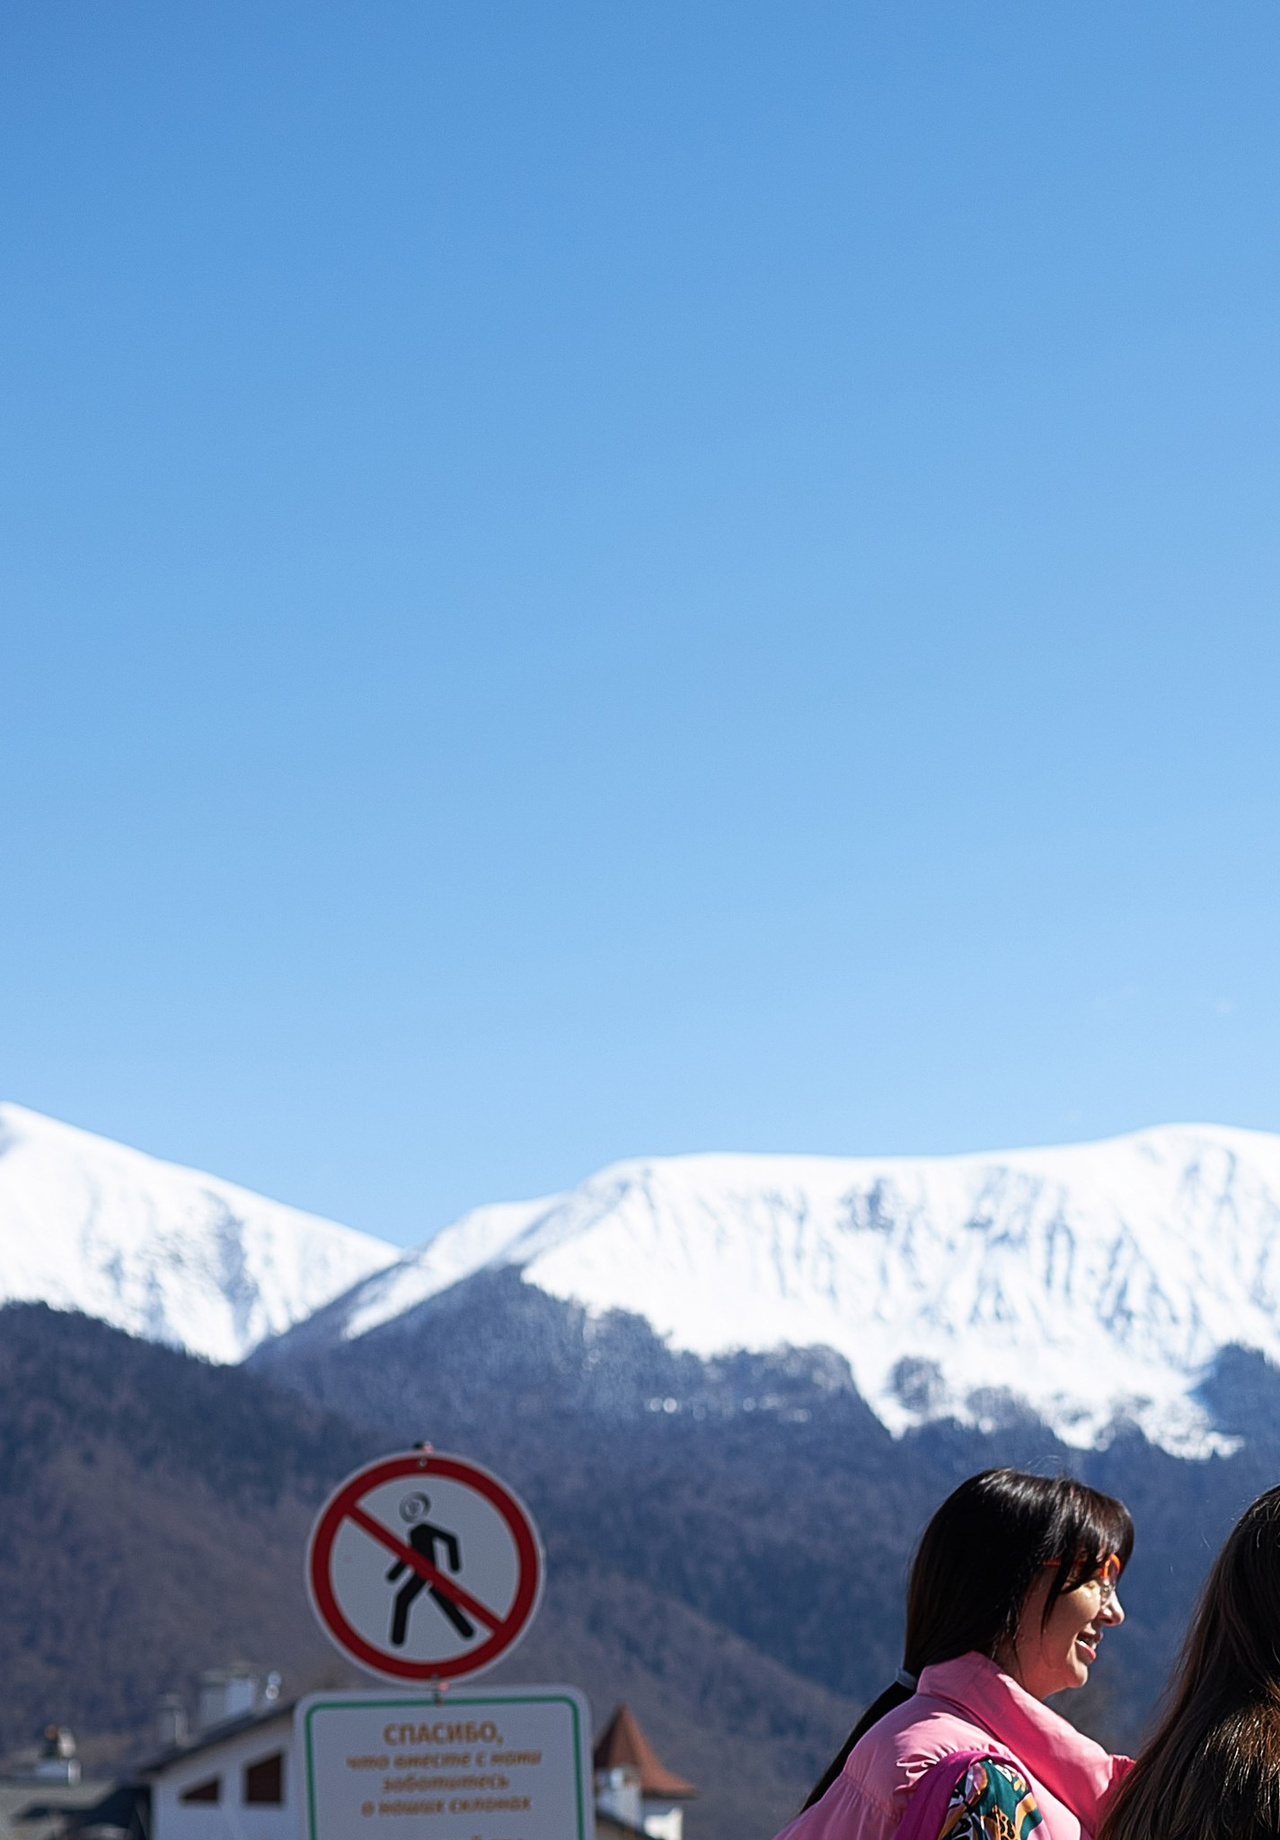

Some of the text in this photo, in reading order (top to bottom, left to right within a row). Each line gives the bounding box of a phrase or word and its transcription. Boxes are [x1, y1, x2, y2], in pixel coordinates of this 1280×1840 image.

[383, 1722, 503, 1746] СПАСИБО,
[347, 1755, 389, 1770] что
[395, 1753, 471, 1768] вместе
[476, 1753, 486, 1767] с
[362, 1802, 374, 1816] о
